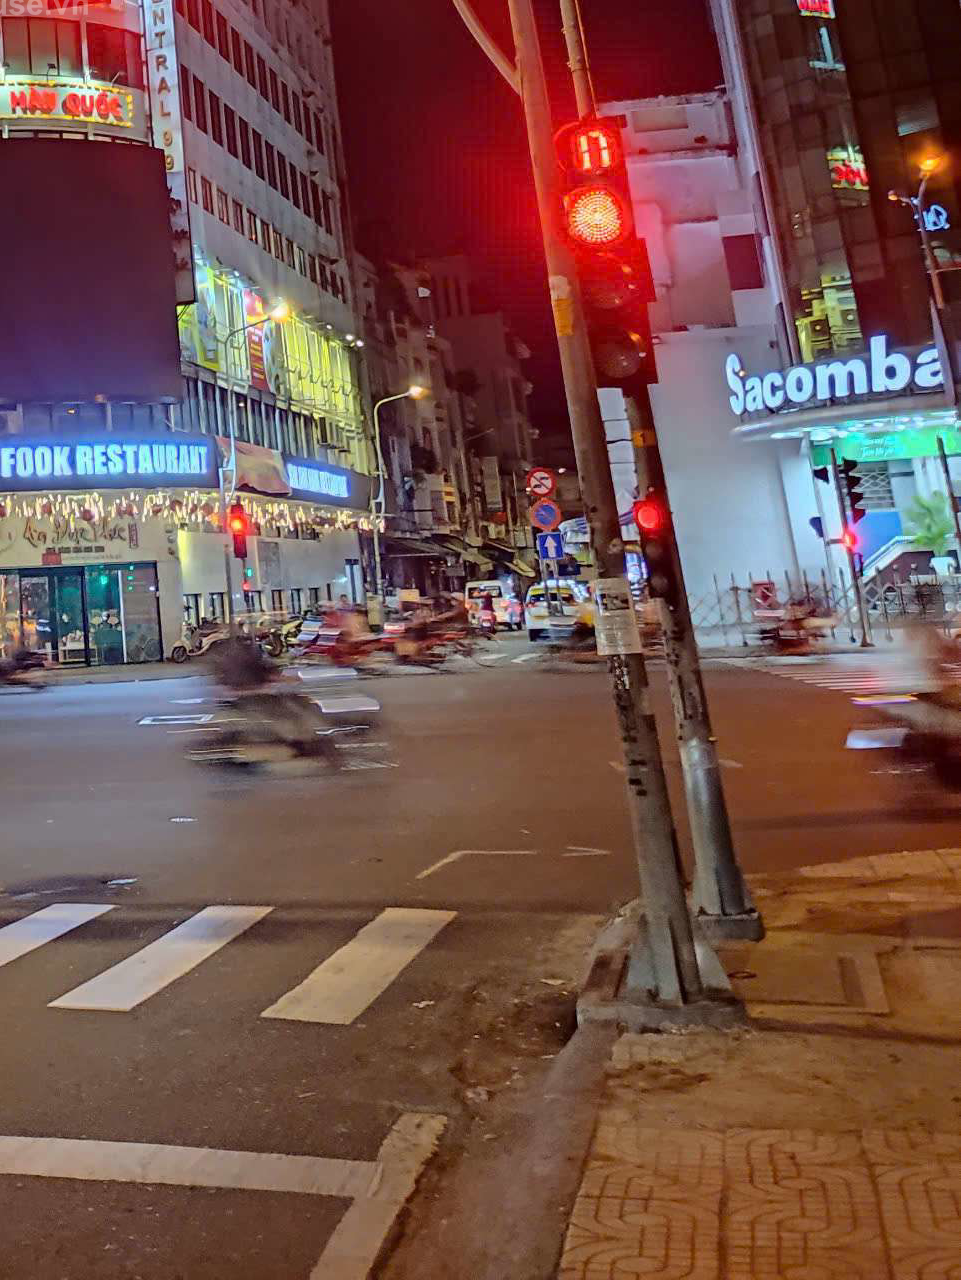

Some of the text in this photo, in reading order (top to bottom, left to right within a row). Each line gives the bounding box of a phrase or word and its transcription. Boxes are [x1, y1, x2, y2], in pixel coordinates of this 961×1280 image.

[10, 85, 57, 114] HÀN
[63, 90, 122, 119] QUỐC
[726, 335, 944, 416] Sacomba
[0, 446, 72, 477] FOOK
[75, 443, 207, 475] RESTAURANT
